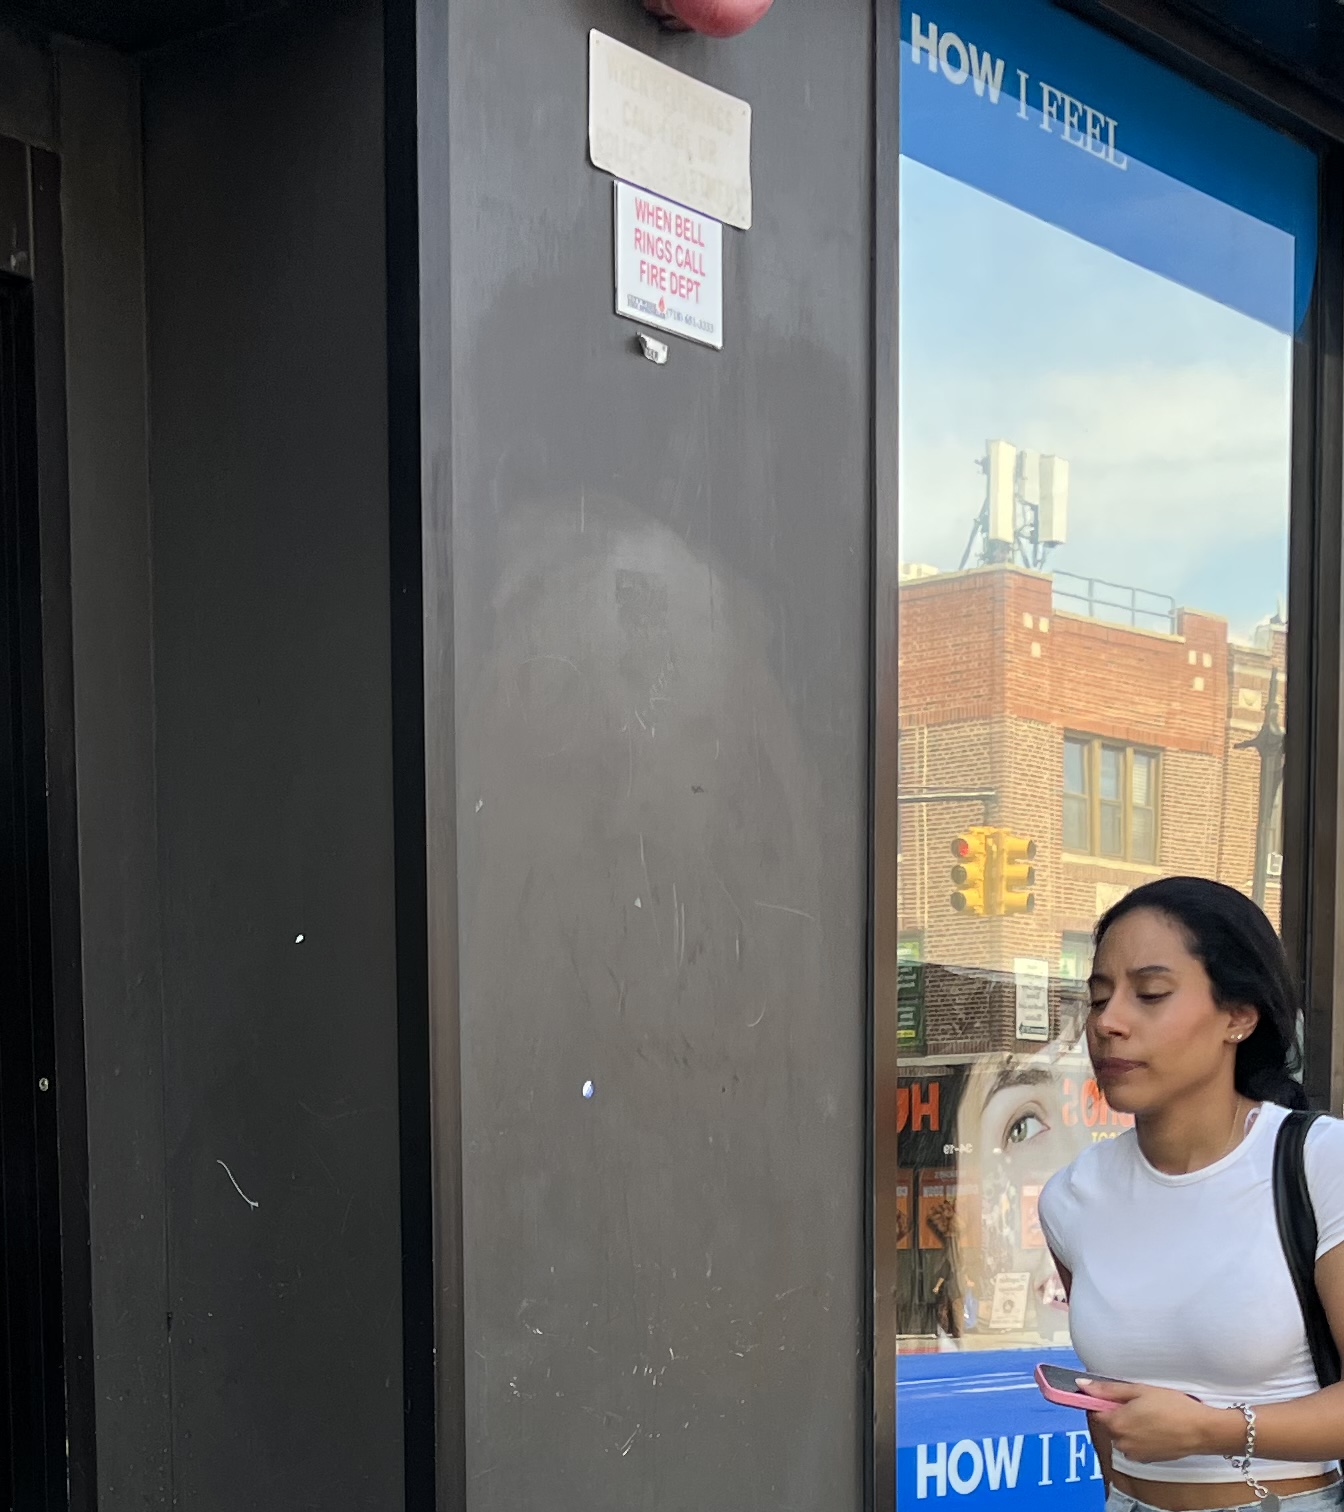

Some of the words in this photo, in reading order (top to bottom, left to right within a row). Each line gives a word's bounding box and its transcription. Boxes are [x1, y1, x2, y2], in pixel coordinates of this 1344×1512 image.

[911, 12, 1005, 105] HOW
[1016, 68, 1030, 121] I
[1039, 81, 1128, 171] FEEL
[634, 197, 672, 234] WHEN
[675, 214, 705, 247] BELL
[634, 228, 673, 264] RINGS
[675, 245, 706, 277] CALL
[639, 259, 667, 292] FIRE
[669, 271, 701, 304] DEPT
[916, 1434, 1025, 1499] HOW
[1037, 1433, 1054, 1486] I
